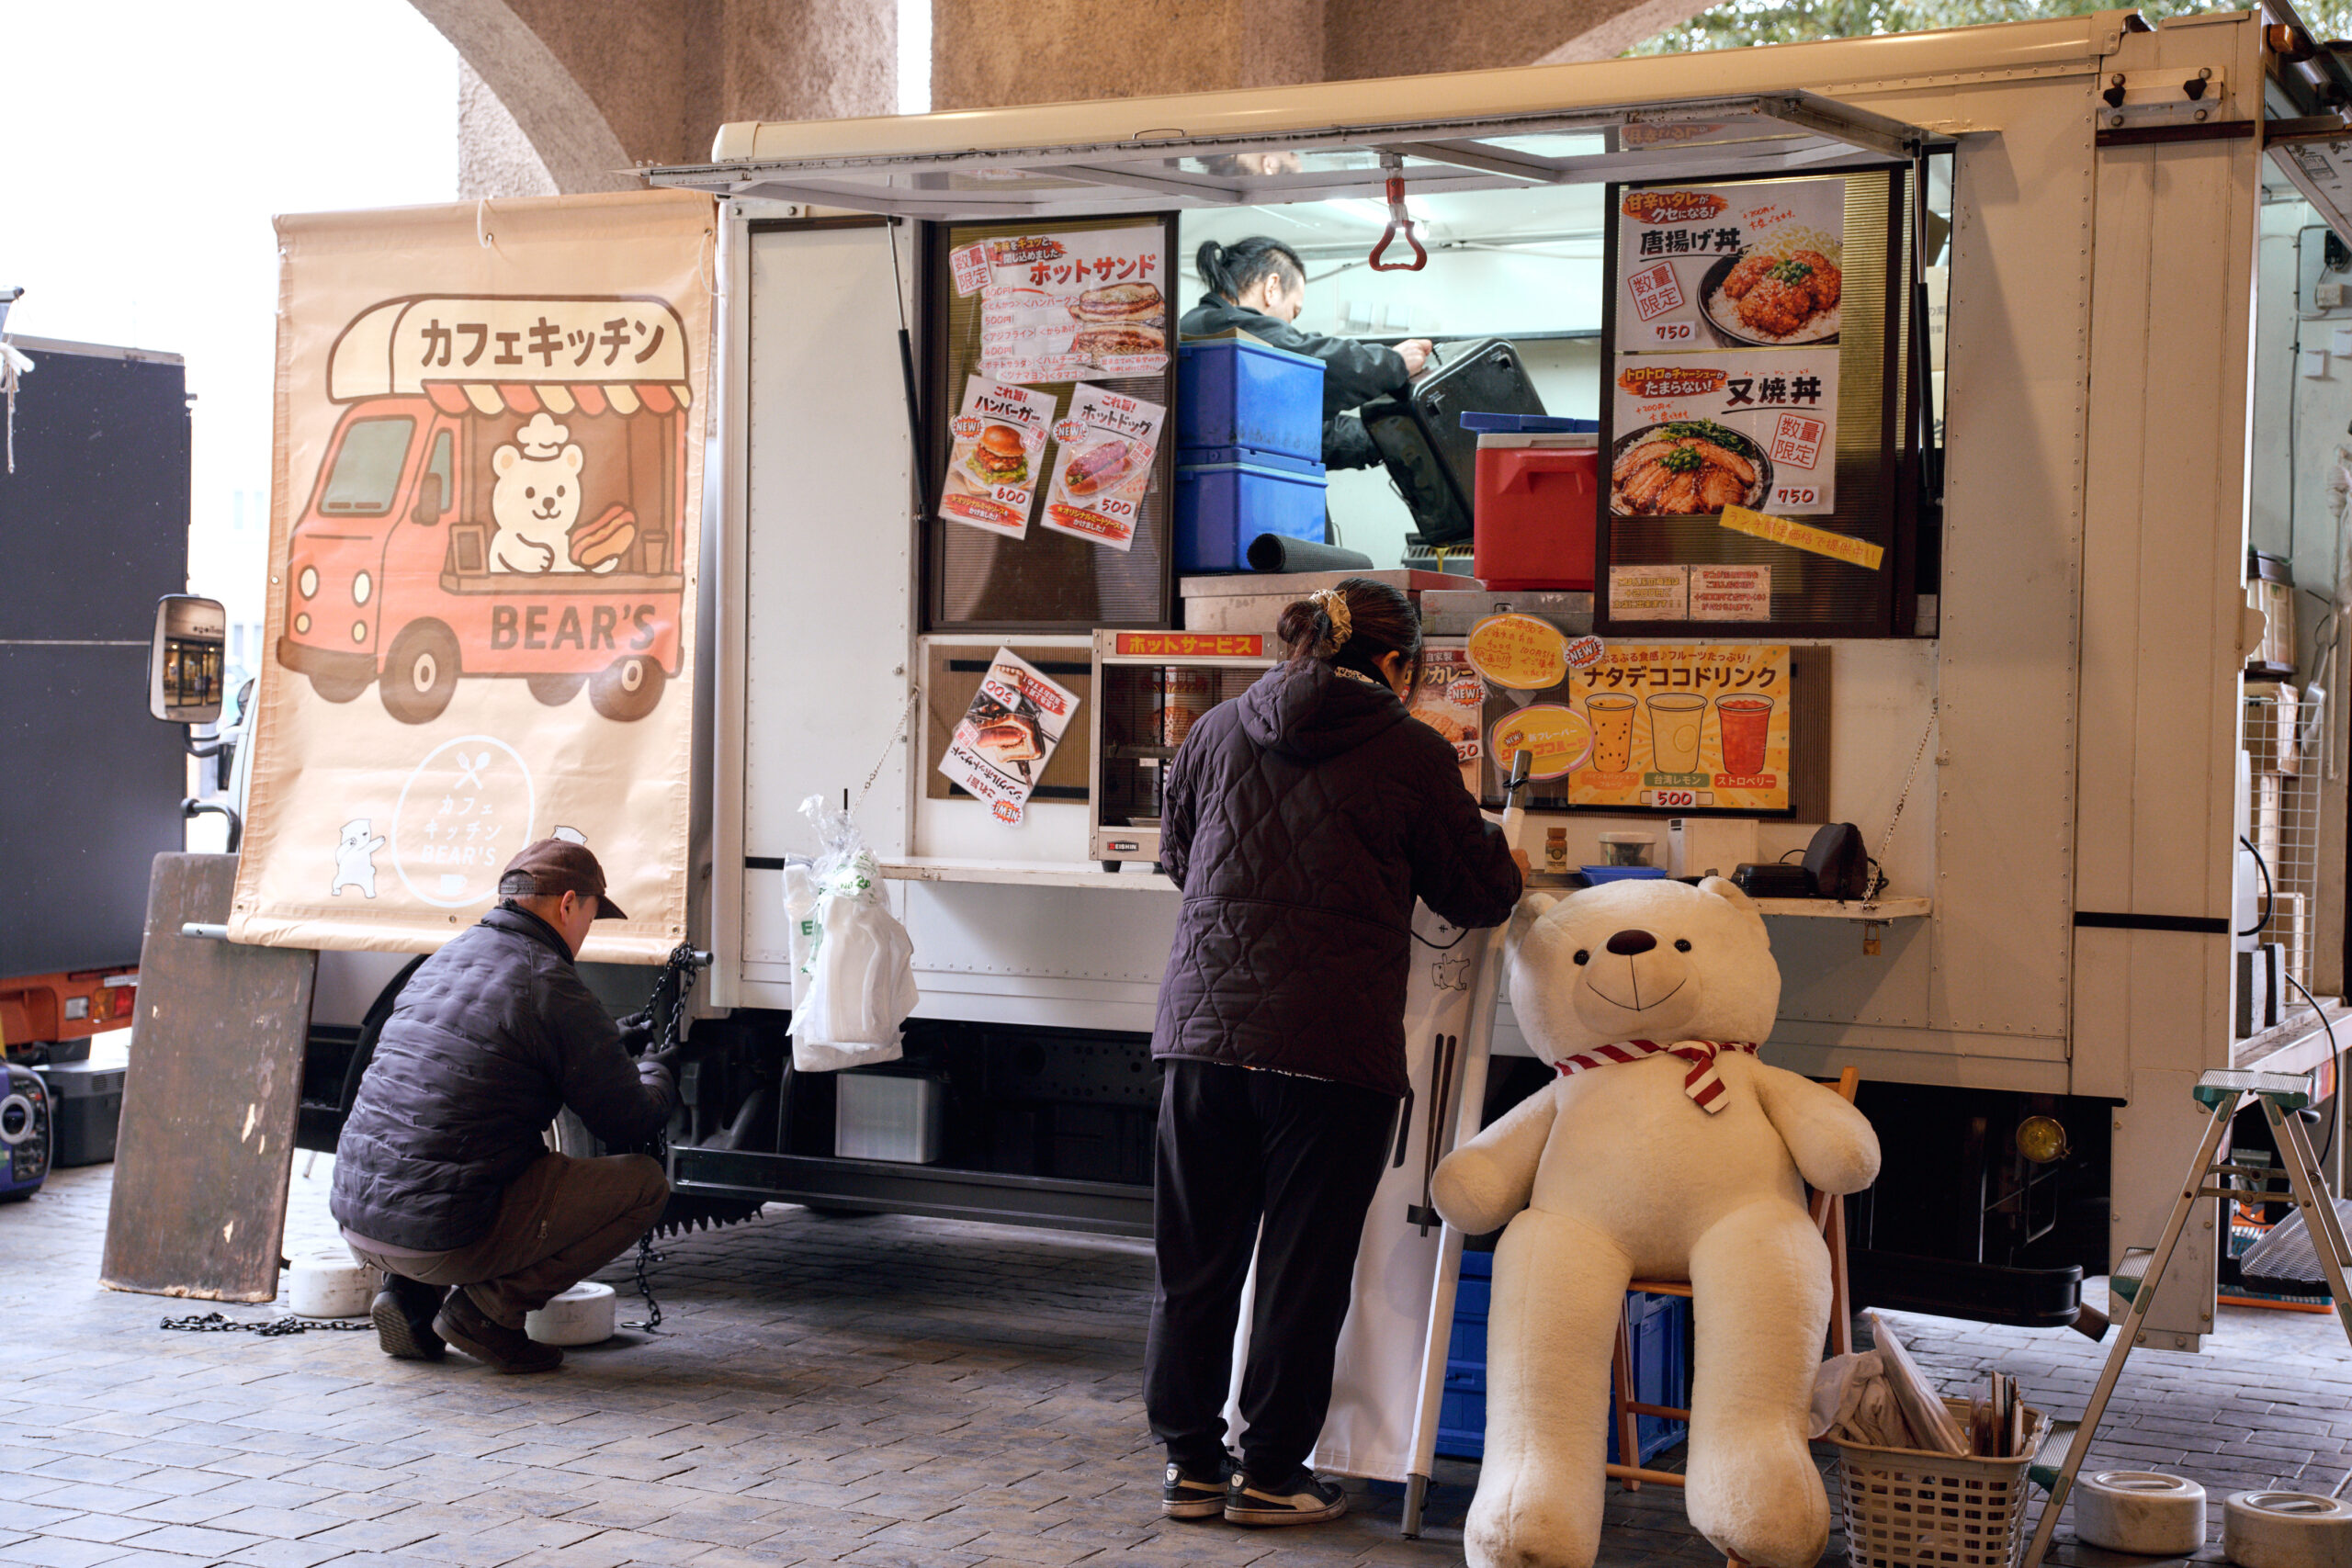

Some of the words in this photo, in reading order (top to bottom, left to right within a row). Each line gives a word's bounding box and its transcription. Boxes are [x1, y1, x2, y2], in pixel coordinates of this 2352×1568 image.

[1627, 191, 1709, 211] 甘辛いタレが
[1651, 206, 1714, 223] クセになる!
[1640, 228, 1741, 256] 唐揚げ丼
[955, 246, 986, 273] 数量
[957, 267, 989, 292] 限定
[1029, 254, 1157, 287] ホットサンド
[1633, 266, 1673, 297] 数量
[1639, 288, 1679, 317] 限定
[985, 315, 1012, 325] 500円
[1657, 324, 1690, 340] 750
[420, 316, 665, 368] カフェキッチン
[1626, 367, 1725, 382] トロトロのチャーシューが
[994, 386, 1028, 403] これ旨!
[1645, 380, 1713, 396] たまらない!
[1726, 377, 1821, 407] 又焼丼
[974, 395, 1041, 423] ハンバーガー
[1102, 395, 1137, 413] これ旨!
[956, 422, 981, 433] NEW!
[1081, 404, 1153, 436] ホットドッグ
[1058, 425, 1085, 438] NEW!
[1782, 416, 1821, 444] 数量
[1776, 439, 1815, 466] 限定
[997, 487, 1026, 504] 600
[1777, 487, 1815, 503] 750
[1102, 497, 1132, 514] 500
[1073, 519, 1106, 534] かけました!
[490, 604, 657, 651] BEAR'S
[1129, 637, 1252, 654] ホットサービス
[1570, 642, 1600, 662] NEW!
[1426, 651, 1453, 662] 自家製
[1583, 667, 1777, 688] ナタデココドリンク
[986, 681, 1013, 705] 500
[1453, 688, 1481, 699] NEW!
[1506, 732, 1523, 745] NEW!
[1528, 728, 1578, 743] 新フレーバー
[1457, 743, 1478, 760] 50
[1501, 737, 1589, 761] グプフルーツ
[950, 746, 1023, 801] シングルホットサンド
[1654, 775, 1702, 786] 台湾レモン
[1717, 775, 1777, 786] ストロベリー
[966, 773, 997, 799] これ旨!
[437, 794, 493, 816] カフェ
[1657, 791, 1692, 806] 500
[993, 802, 1019, 821] NEW!
[423, 818, 503, 841] キッチン
[420, 844, 497, 867] BEAR'S
